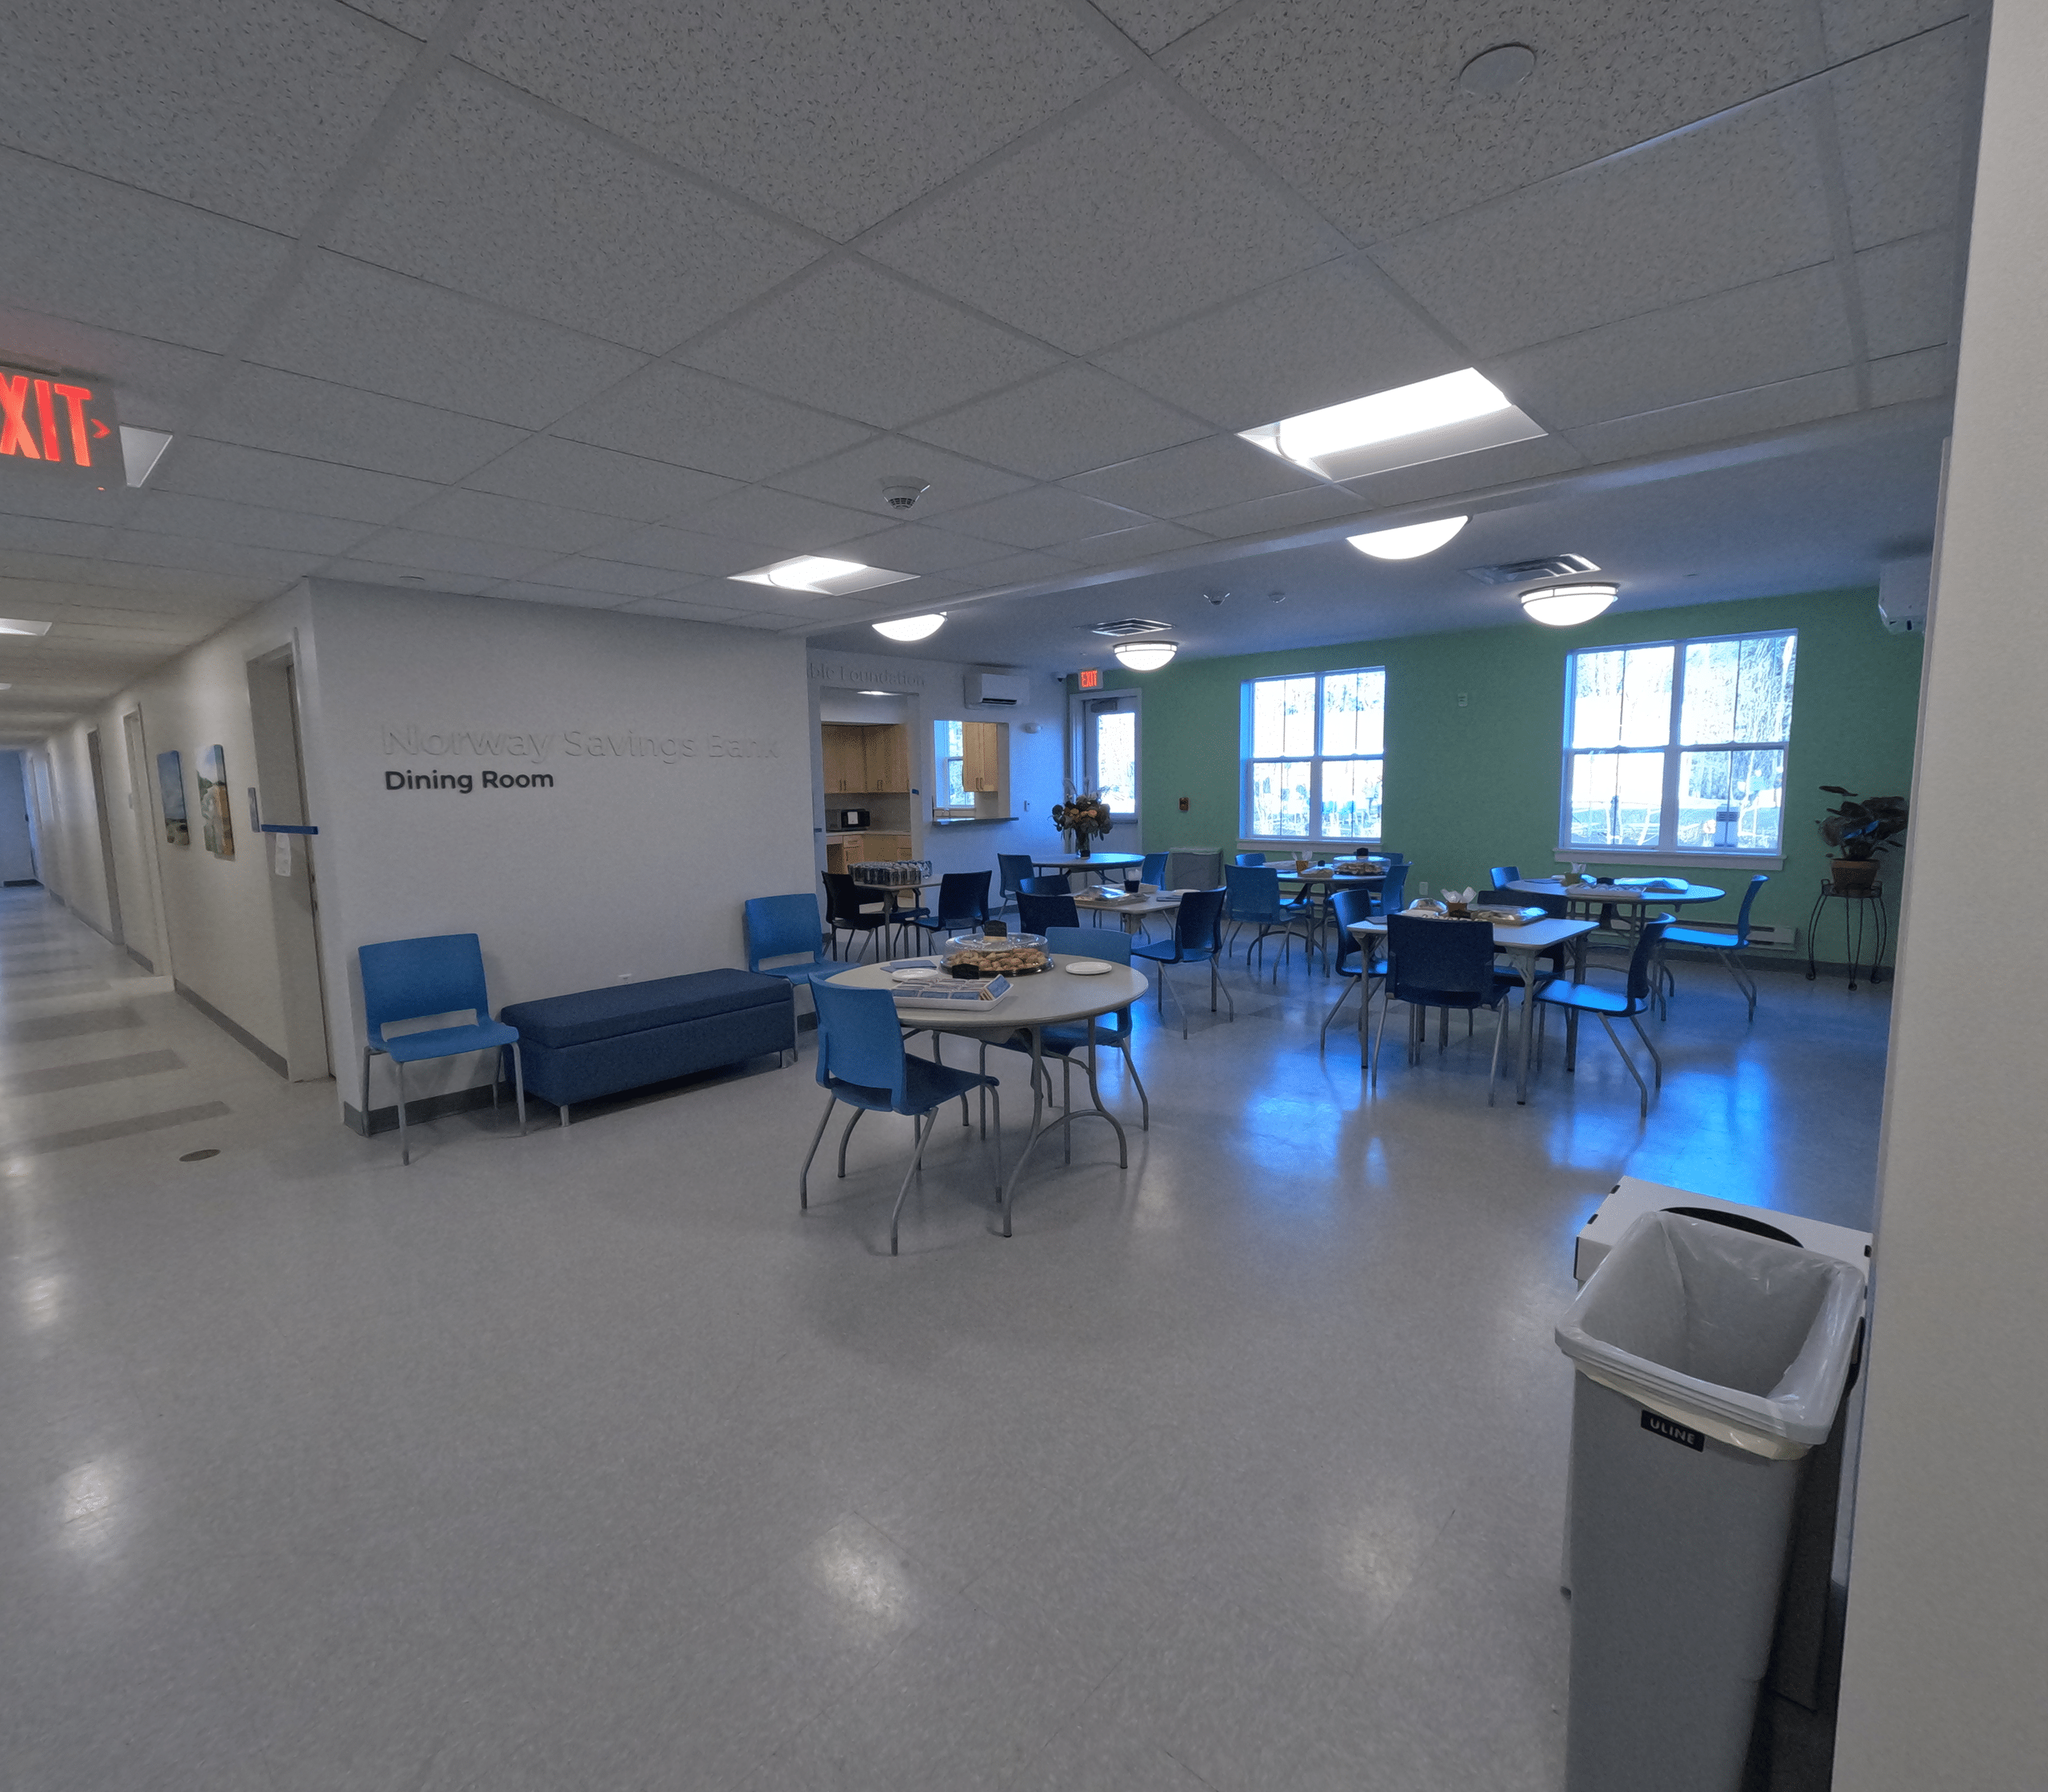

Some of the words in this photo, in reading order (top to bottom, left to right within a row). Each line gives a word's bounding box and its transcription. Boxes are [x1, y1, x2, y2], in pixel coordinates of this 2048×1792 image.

[841, 666, 925, 687] Foundation
[1081, 670, 1098, 687] EXIT
[381, 724, 555, 765] Norway
[563, 729, 695, 765] Savings
[706, 730, 779, 758] Bank
[384, 769, 474, 794] Dining
[481, 770, 554, 789] Room
[1650, 1418, 1696, 1445] ULINE
